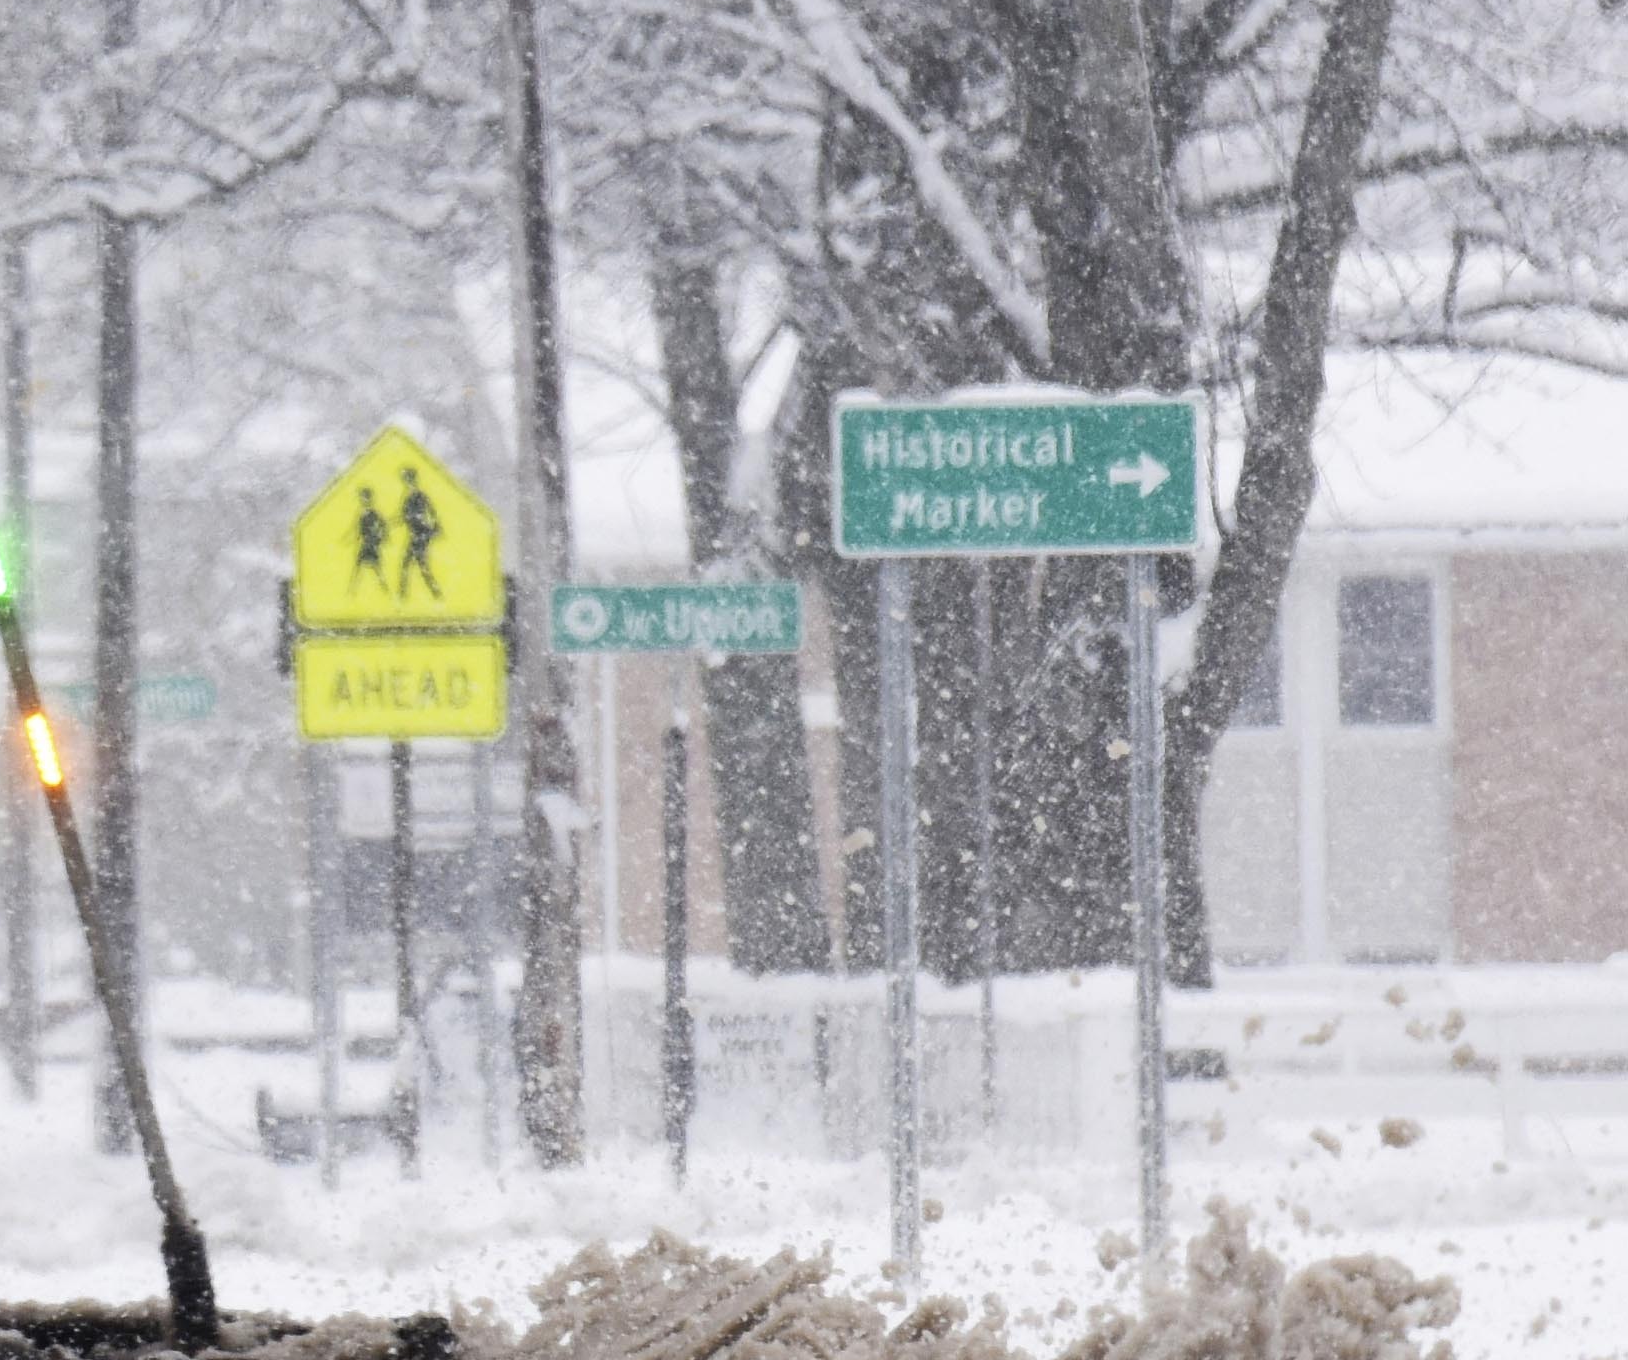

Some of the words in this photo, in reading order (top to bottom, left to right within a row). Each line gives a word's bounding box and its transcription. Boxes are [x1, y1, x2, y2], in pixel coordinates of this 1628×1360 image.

[863, 419, 1075, 471] Historical
[890, 487, 1048, 533] Marker
[329, 665, 473, 710] AHEAD
